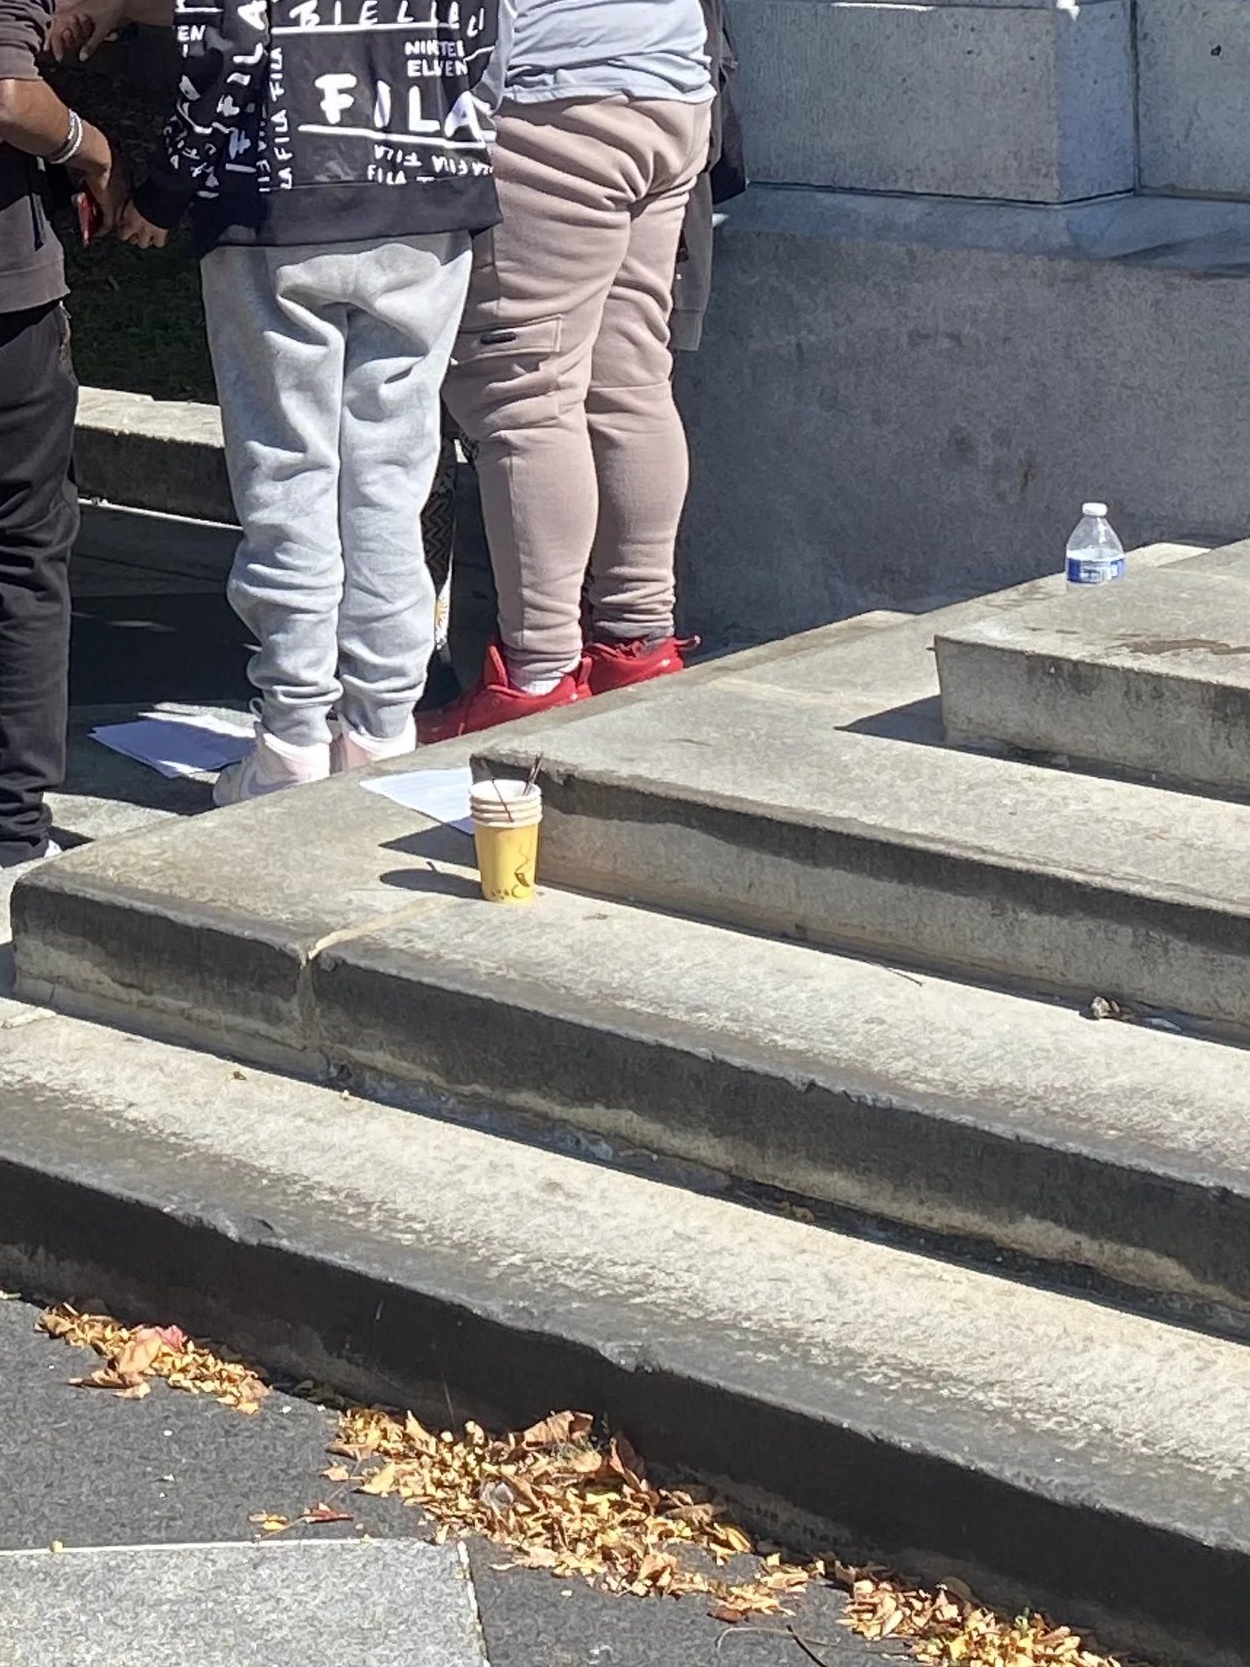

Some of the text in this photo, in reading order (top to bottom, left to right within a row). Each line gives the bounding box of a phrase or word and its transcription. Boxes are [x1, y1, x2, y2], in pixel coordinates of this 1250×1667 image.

[269, 47, 284, 102] FILA
[315, 73, 487, 142] FILA
[270, 109, 291, 162] FILA
[373, 144, 423, 166] FILA
[366, 164, 407, 185] FILA
